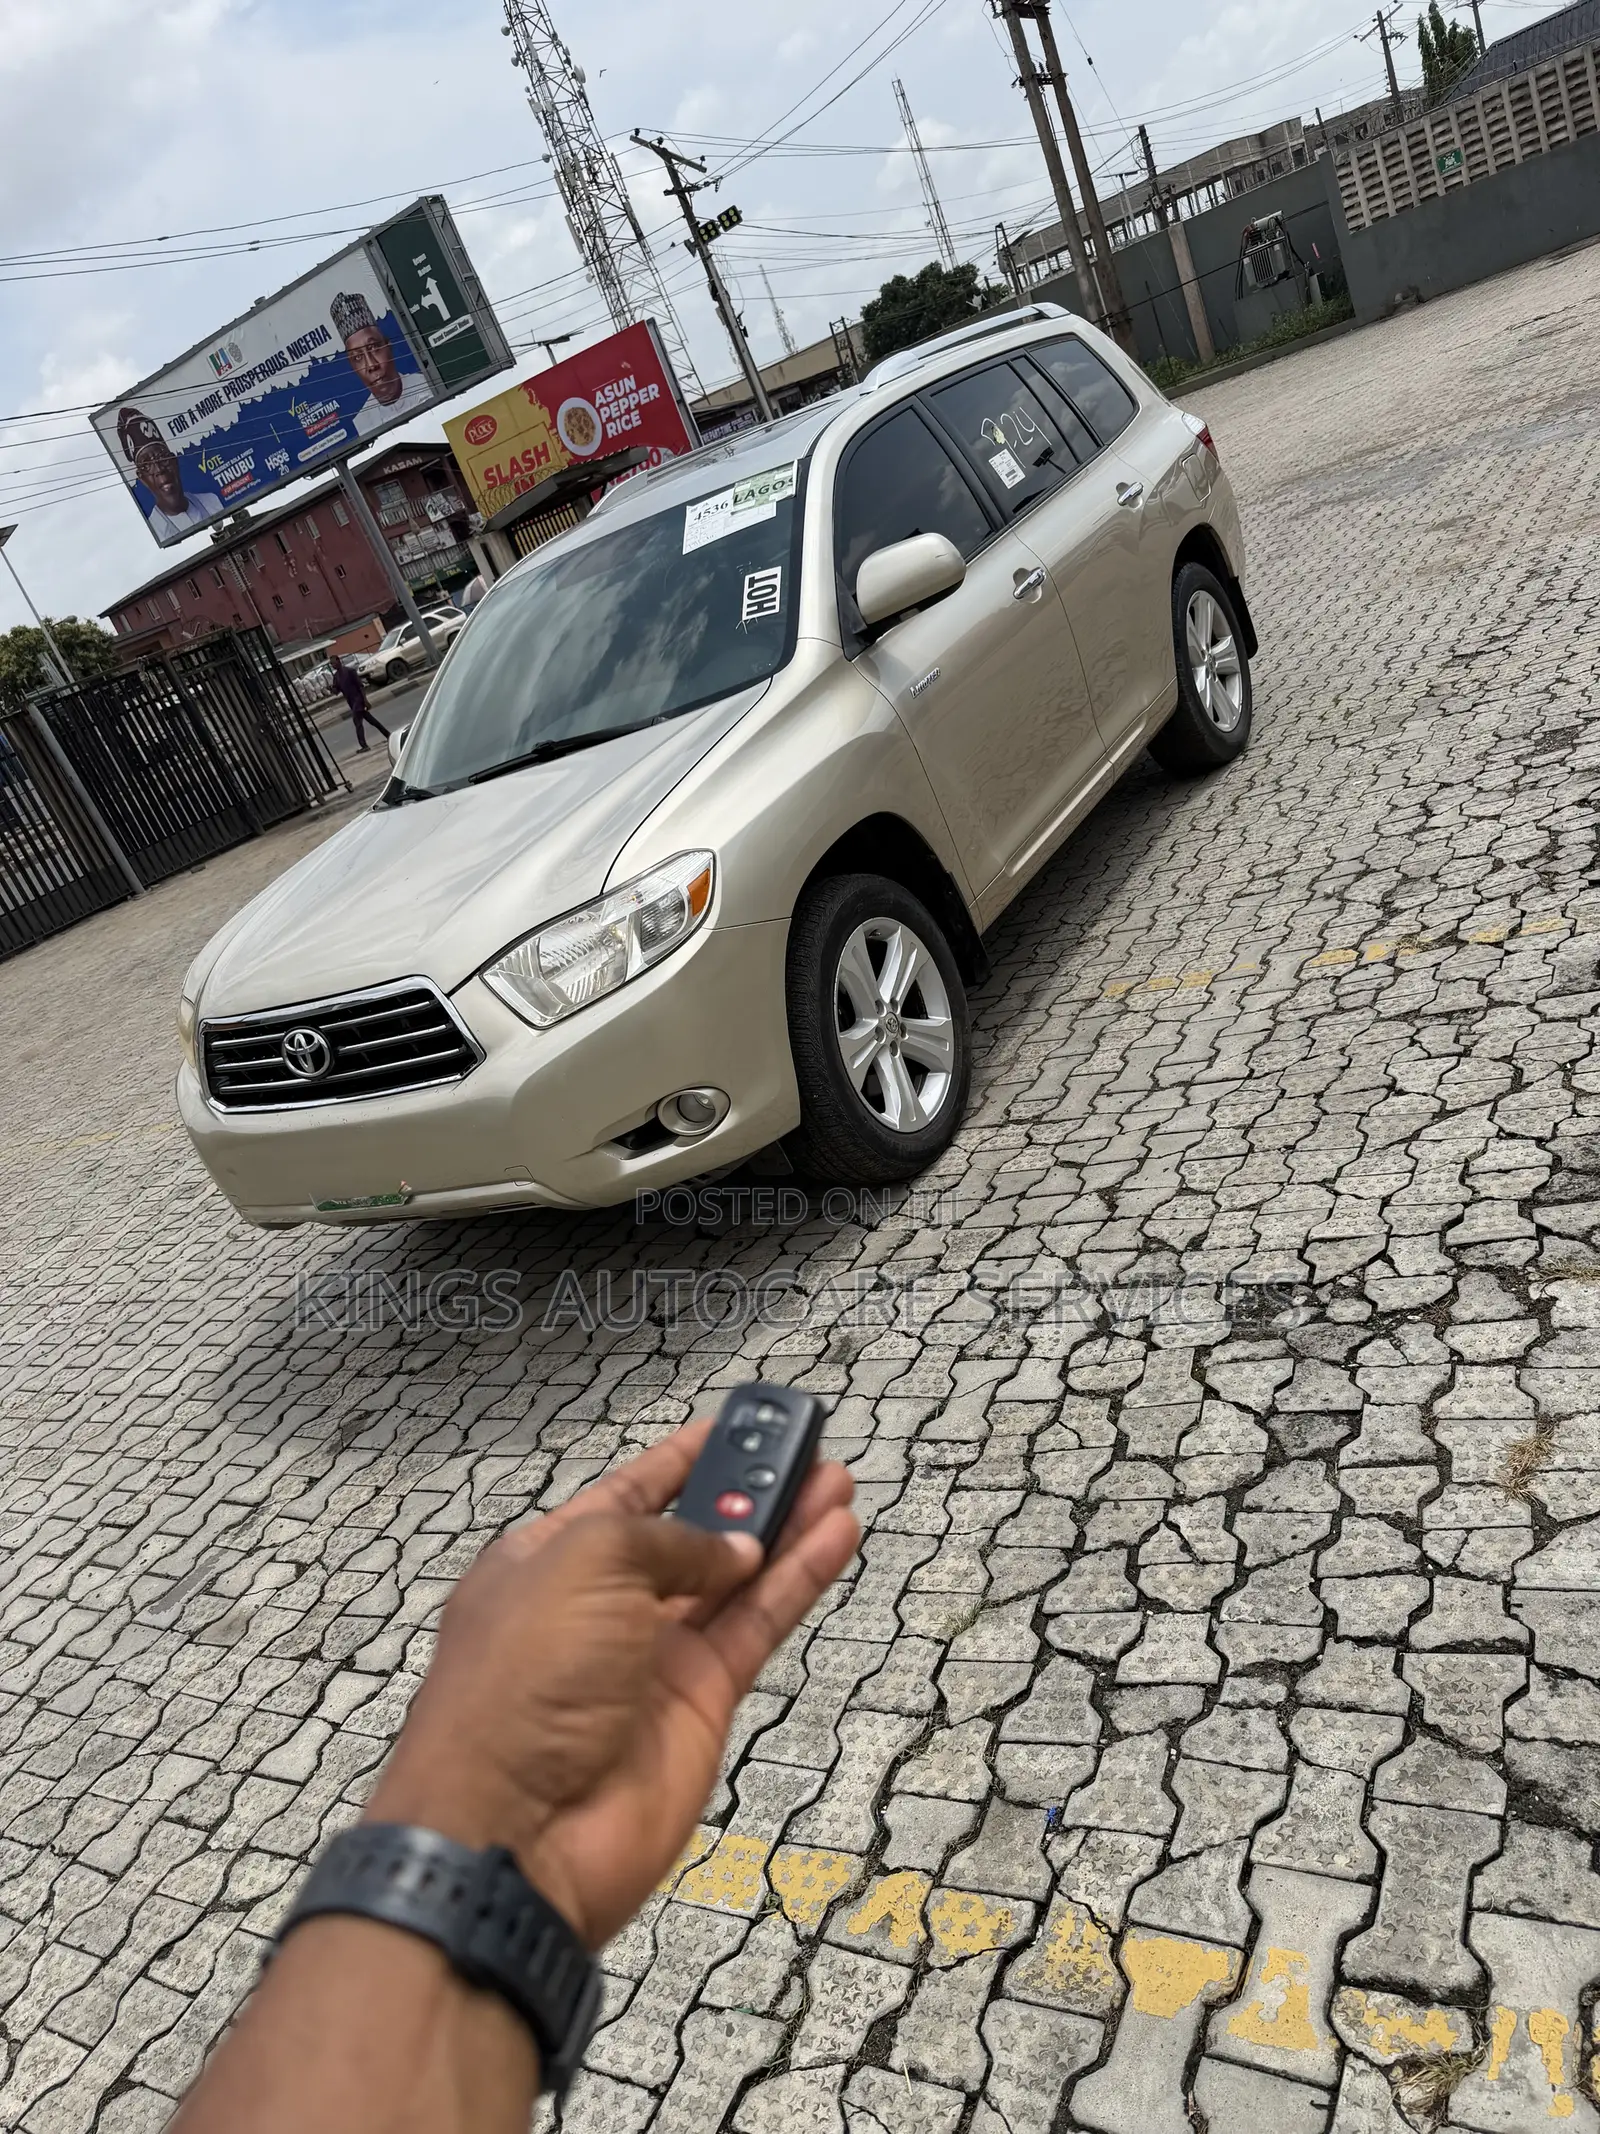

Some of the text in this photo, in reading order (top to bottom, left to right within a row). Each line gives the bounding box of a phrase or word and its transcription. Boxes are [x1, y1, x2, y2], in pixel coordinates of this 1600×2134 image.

[167, 324, 333, 437] FOR A MORE PROSPEROUS NIGERIA
[595, 374, 637, 408] ASUN
[300, 399, 340, 428] SHETTIMA
[599, 383, 660, 423] PEPPER
[606, 409, 642, 439] RICE
[213, 455, 255, 487] TINUBU
[264, 452, 290, 472] Hope
[484, 441, 552, 490] SLASH
[693, 500, 729, 521] 4536
[746, 573, 778, 617] HOT
